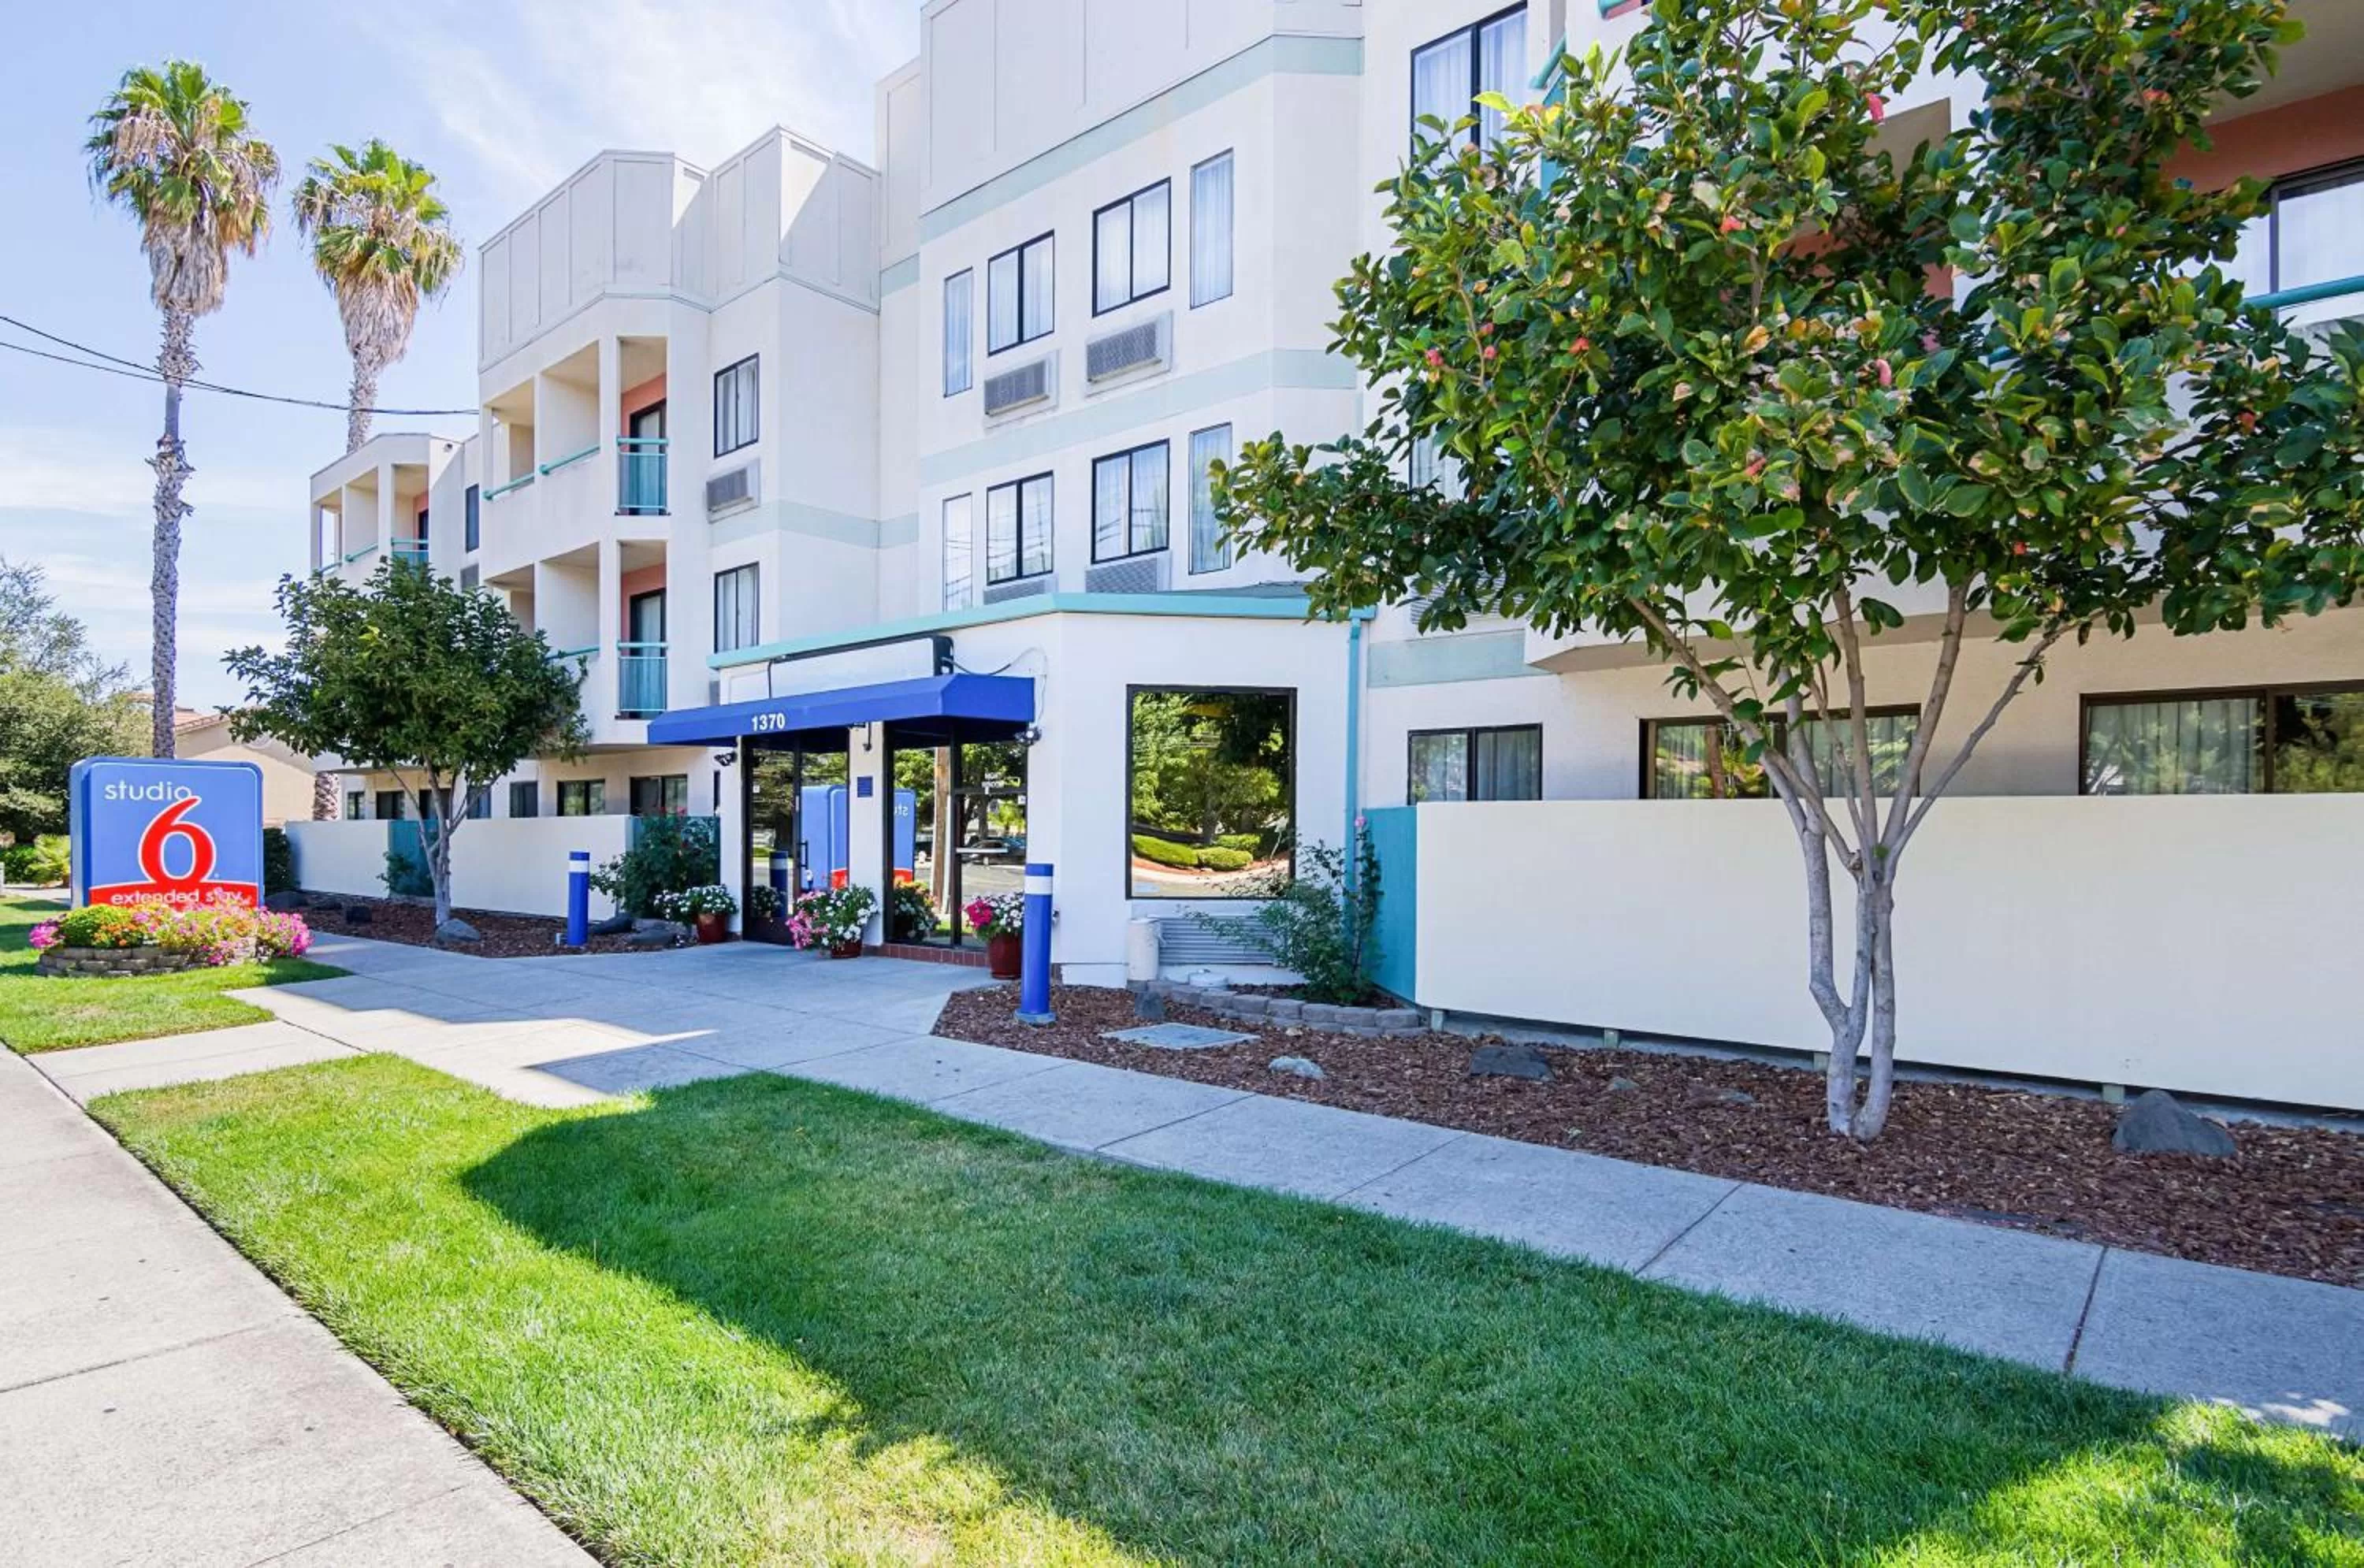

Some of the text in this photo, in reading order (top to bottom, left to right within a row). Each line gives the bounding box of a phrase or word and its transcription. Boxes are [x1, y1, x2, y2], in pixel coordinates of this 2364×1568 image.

[751, 712, 786, 732] 1370
[104, 780, 192, 801] studio
[139, 796, 217, 886] 6
[110, 888, 243, 905] extended say
